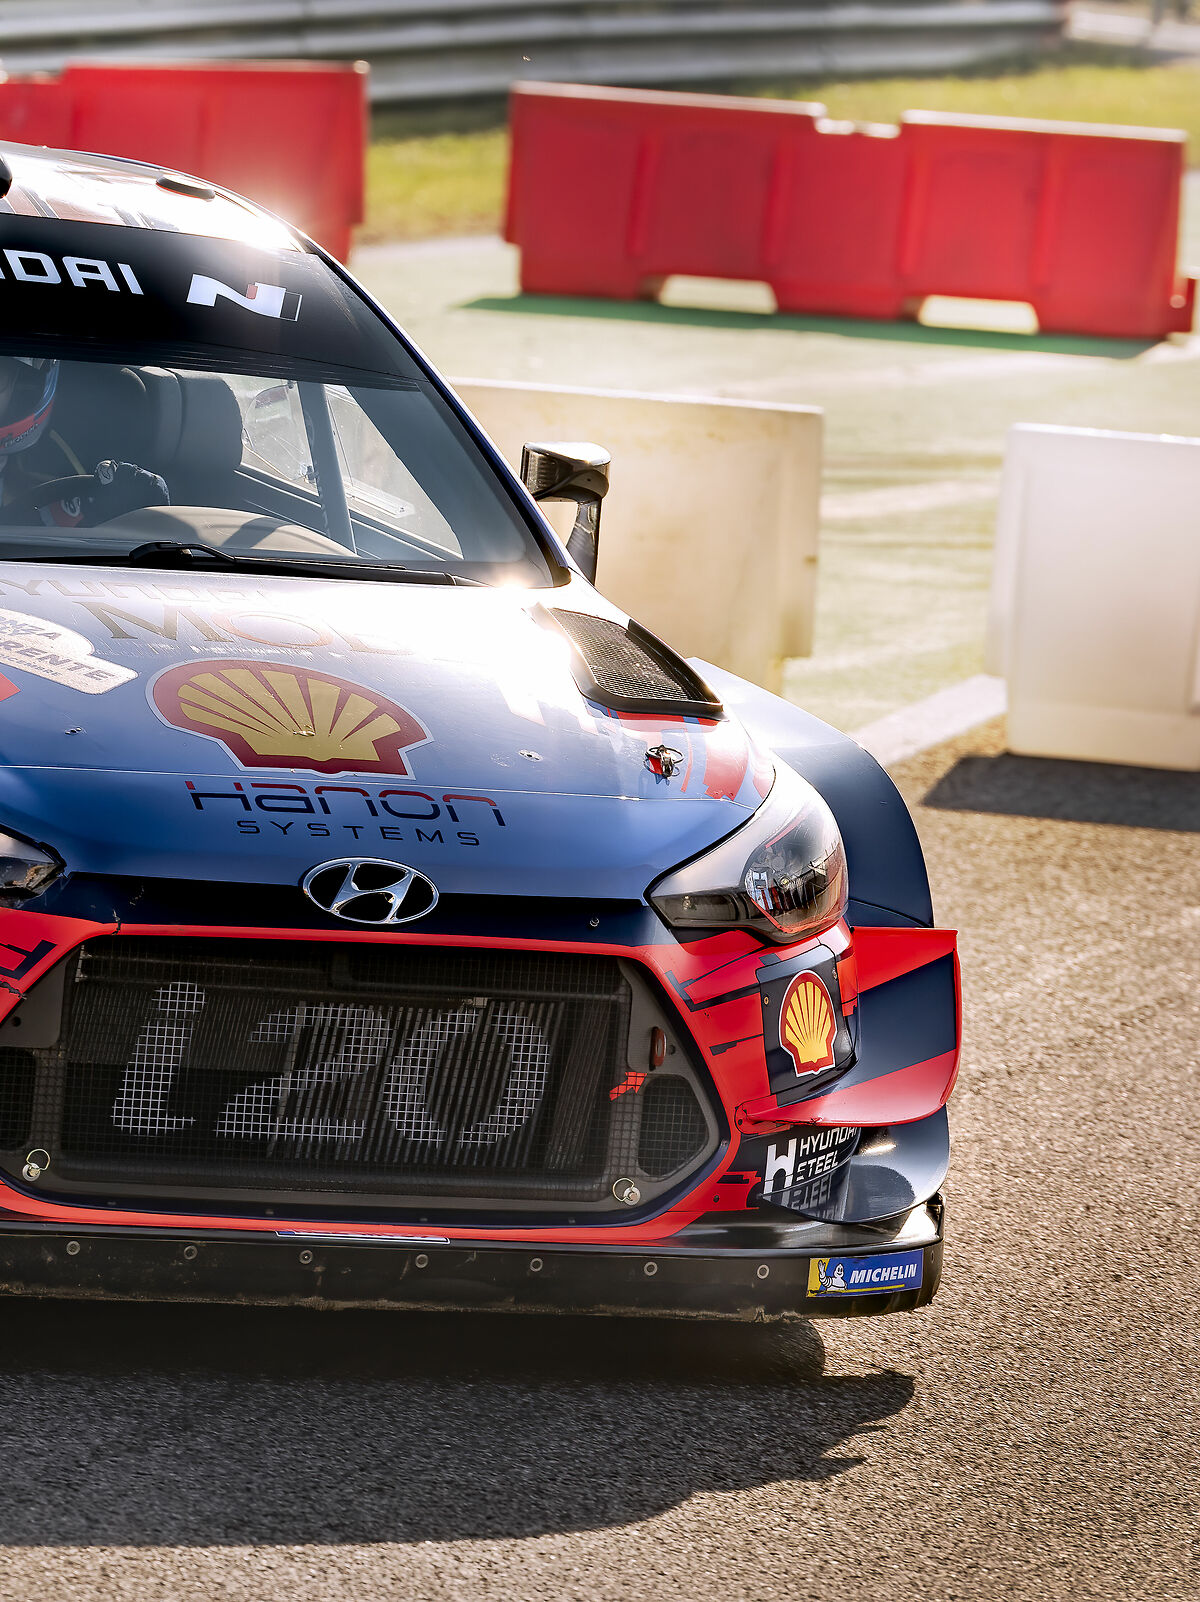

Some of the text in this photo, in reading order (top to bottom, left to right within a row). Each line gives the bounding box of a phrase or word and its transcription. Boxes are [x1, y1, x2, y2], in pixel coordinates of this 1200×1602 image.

[236, 819, 481, 847] SYSTEMS
[795, 1149, 839, 1182] STEEL
[849, 1263, 918, 1284] MICHELIN
